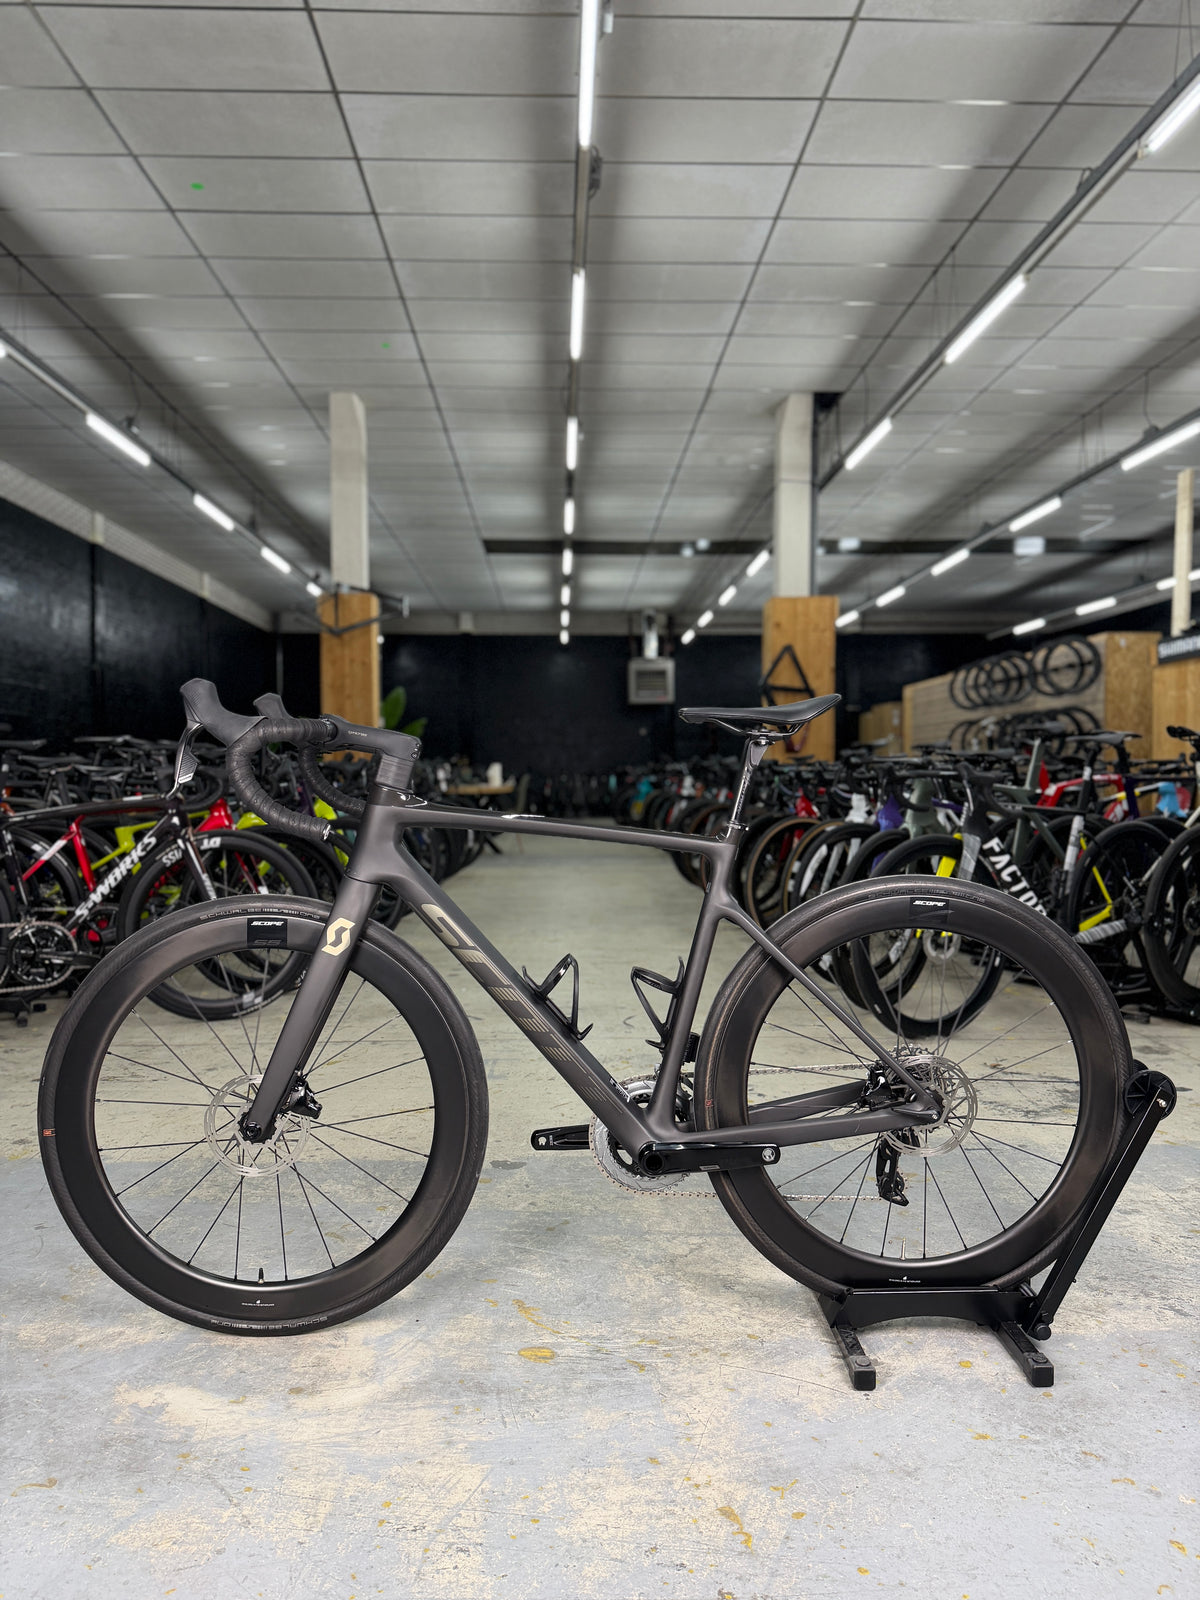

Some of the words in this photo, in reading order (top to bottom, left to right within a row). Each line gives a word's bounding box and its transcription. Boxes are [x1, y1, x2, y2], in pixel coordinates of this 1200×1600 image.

[200, 837, 221, 850] DT
[74, 835, 158, 924] S-WORKS
[200, 908, 261, 920] SCHWALBE
[268, 1316, 328, 1330] SCHWALBE
